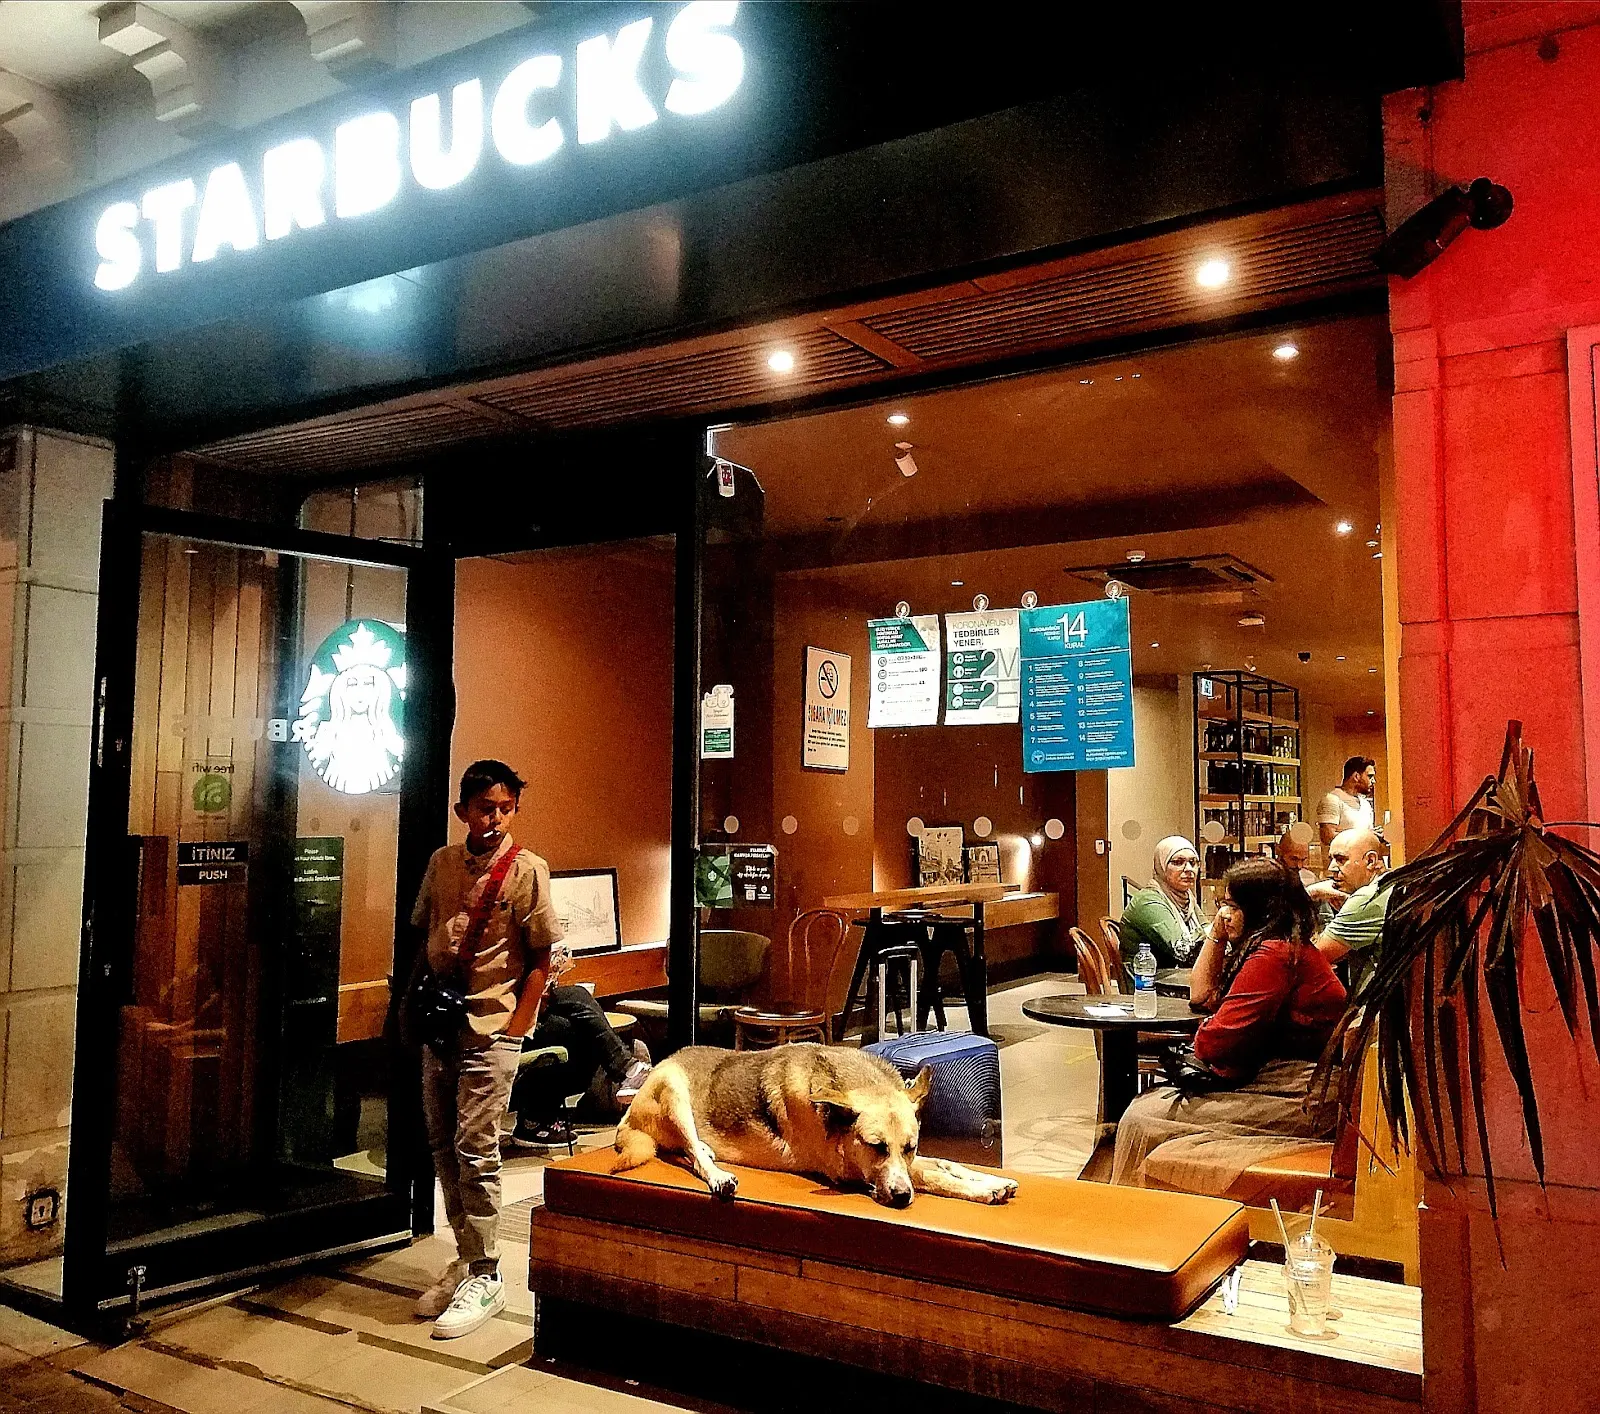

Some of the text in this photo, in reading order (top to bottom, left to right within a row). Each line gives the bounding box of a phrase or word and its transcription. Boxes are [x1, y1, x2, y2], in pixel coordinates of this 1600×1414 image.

[93, 1, 746, 291] STARBUCKS
[1057, 611, 1088, 642] 14
[953, 628, 1000, 638] TEDBİRLER
[1064, 642, 1086, 650] KURAL
[199, 870, 228, 880] PUSH
